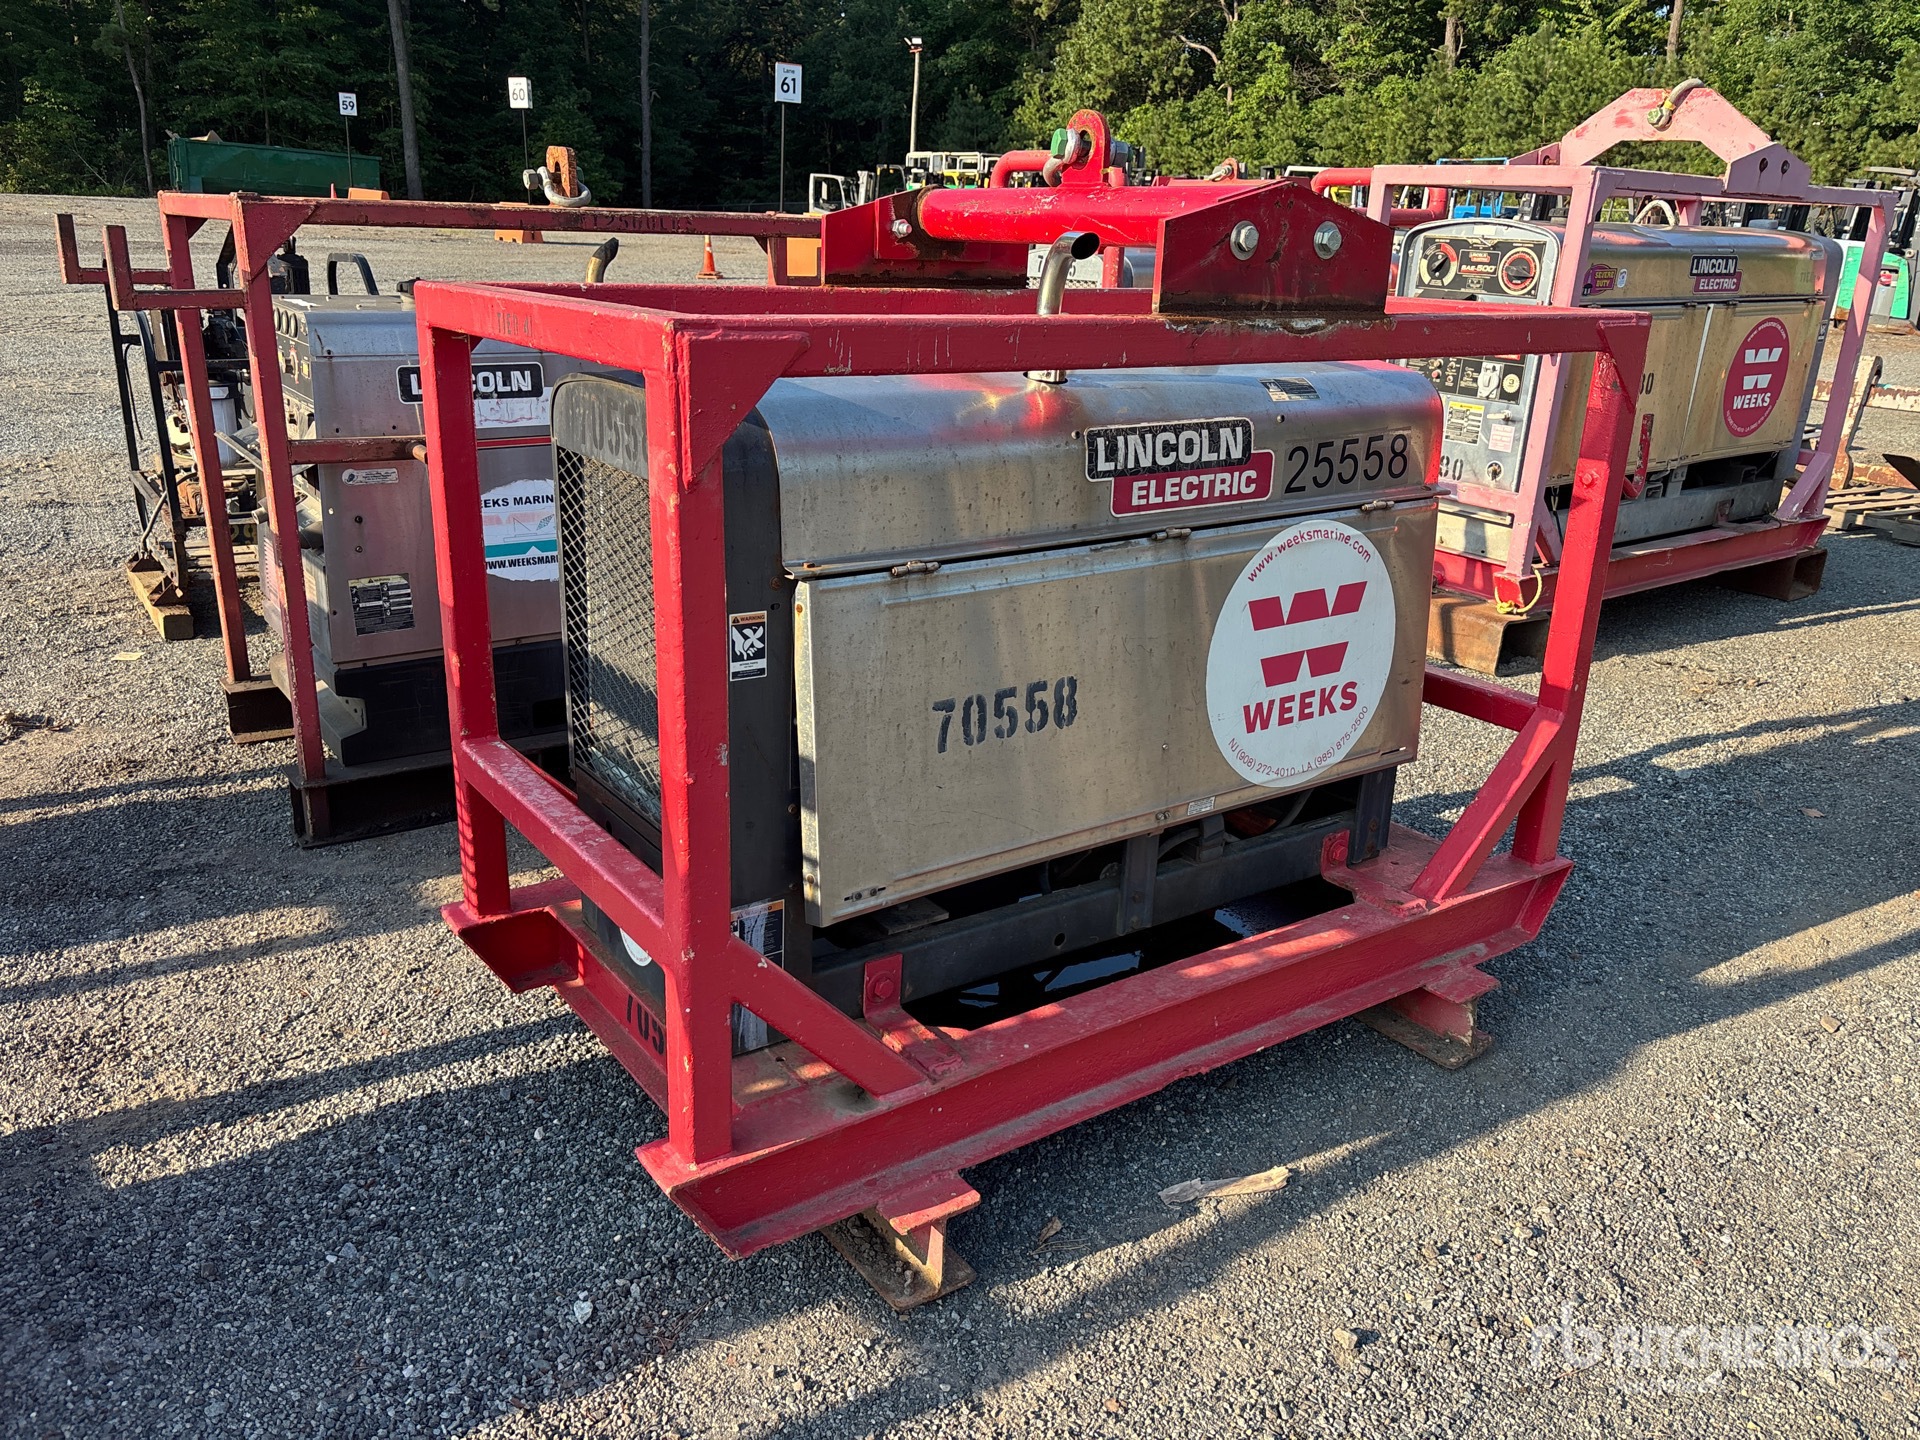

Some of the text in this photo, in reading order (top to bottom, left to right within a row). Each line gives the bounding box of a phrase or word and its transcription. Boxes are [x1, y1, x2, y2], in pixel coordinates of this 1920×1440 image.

[512, 87, 525, 101] 60
[780, 76, 796, 94] 61
[341, 100, 355, 111] 59
[1691, 258, 1736, 274] LINCOLN
[1698, 277, 1737, 290] ELECTRIC
[409, 369, 532, 396] LOLN
[1508, 378, 1515, 386] 3
[1732, 392, 1771, 410] WEEKS
[1096, 426, 1244, 472] LINCOLN
[1284, 433, 1408, 494] 25558
[1131, 469, 1257, 506] ELECTRIC
[482, 497, 509, 508] EKS
[1247, 528, 1371, 582] www.weeksmarine.com
[740, 614, 765, 622] WARNING
[932, 676, 1078, 754] 70558
[1242, 681, 1358, 734] WEEKS
[1228, 705, 1369, 777] NJ (908) 272-4010 LA (985) 875-2500
